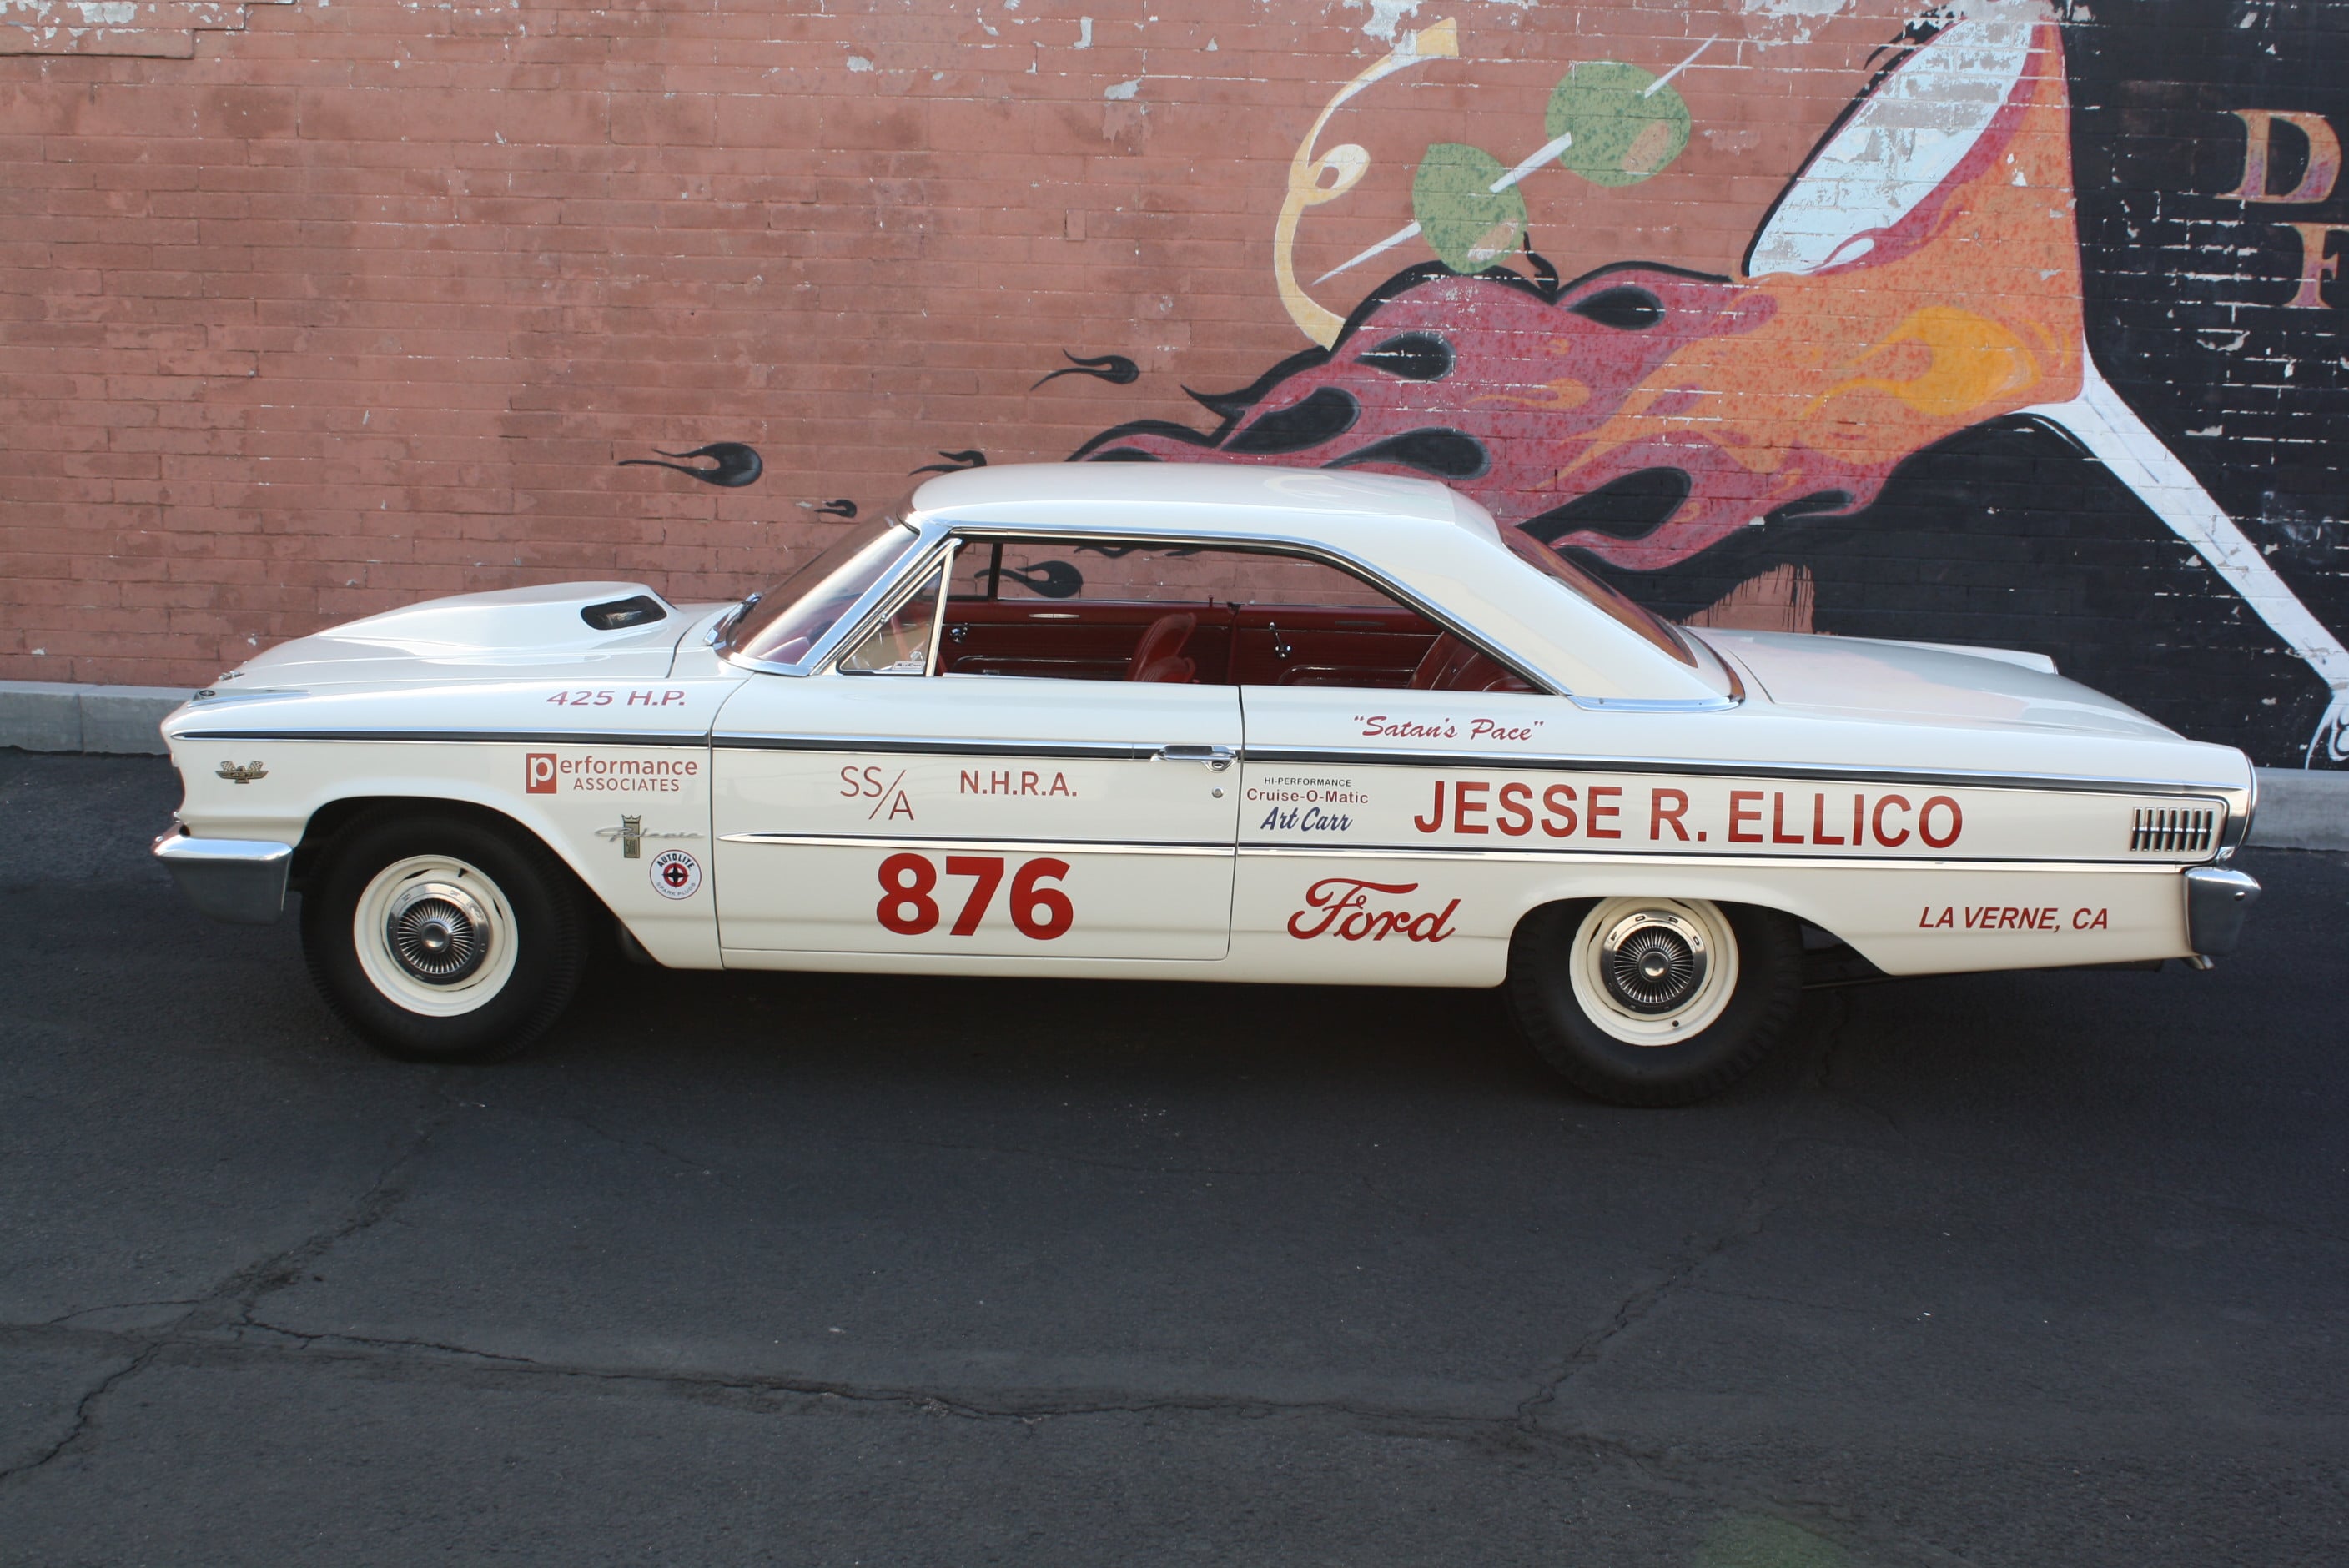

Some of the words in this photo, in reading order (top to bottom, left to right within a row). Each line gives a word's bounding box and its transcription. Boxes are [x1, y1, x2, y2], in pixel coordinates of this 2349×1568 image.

[2213, 108, 2342, 204] D
[546, 691, 615, 706] 425
[627, 691, 686, 706] H.P.
[573, 778, 680, 792] ASSOCIATES
[960, 769, 1077, 797] N.H.R.A.
[1264, 777, 1352, 787] HI-PERFORMANCE
[1247, 788, 1369, 803] Cruise-O-Matic
[1260, 807, 1299, 831] Art
[1301, 807, 1353, 832] Carr
[1414, 780, 1622, 837] JESSE
[1649, 787, 1707, 842] R.
[1728, 790, 1963, 849] ELLICO
[656, 852, 695, 870] AUTOLITE
[876, 852, 1074, 941] 876
[1287, 877, 1461, 942] Ford
[1919, 906, 1954, 928] LA
[1964, 907, 2060, 933] VERNE,
[2072, 907, 2108, 930] CA
